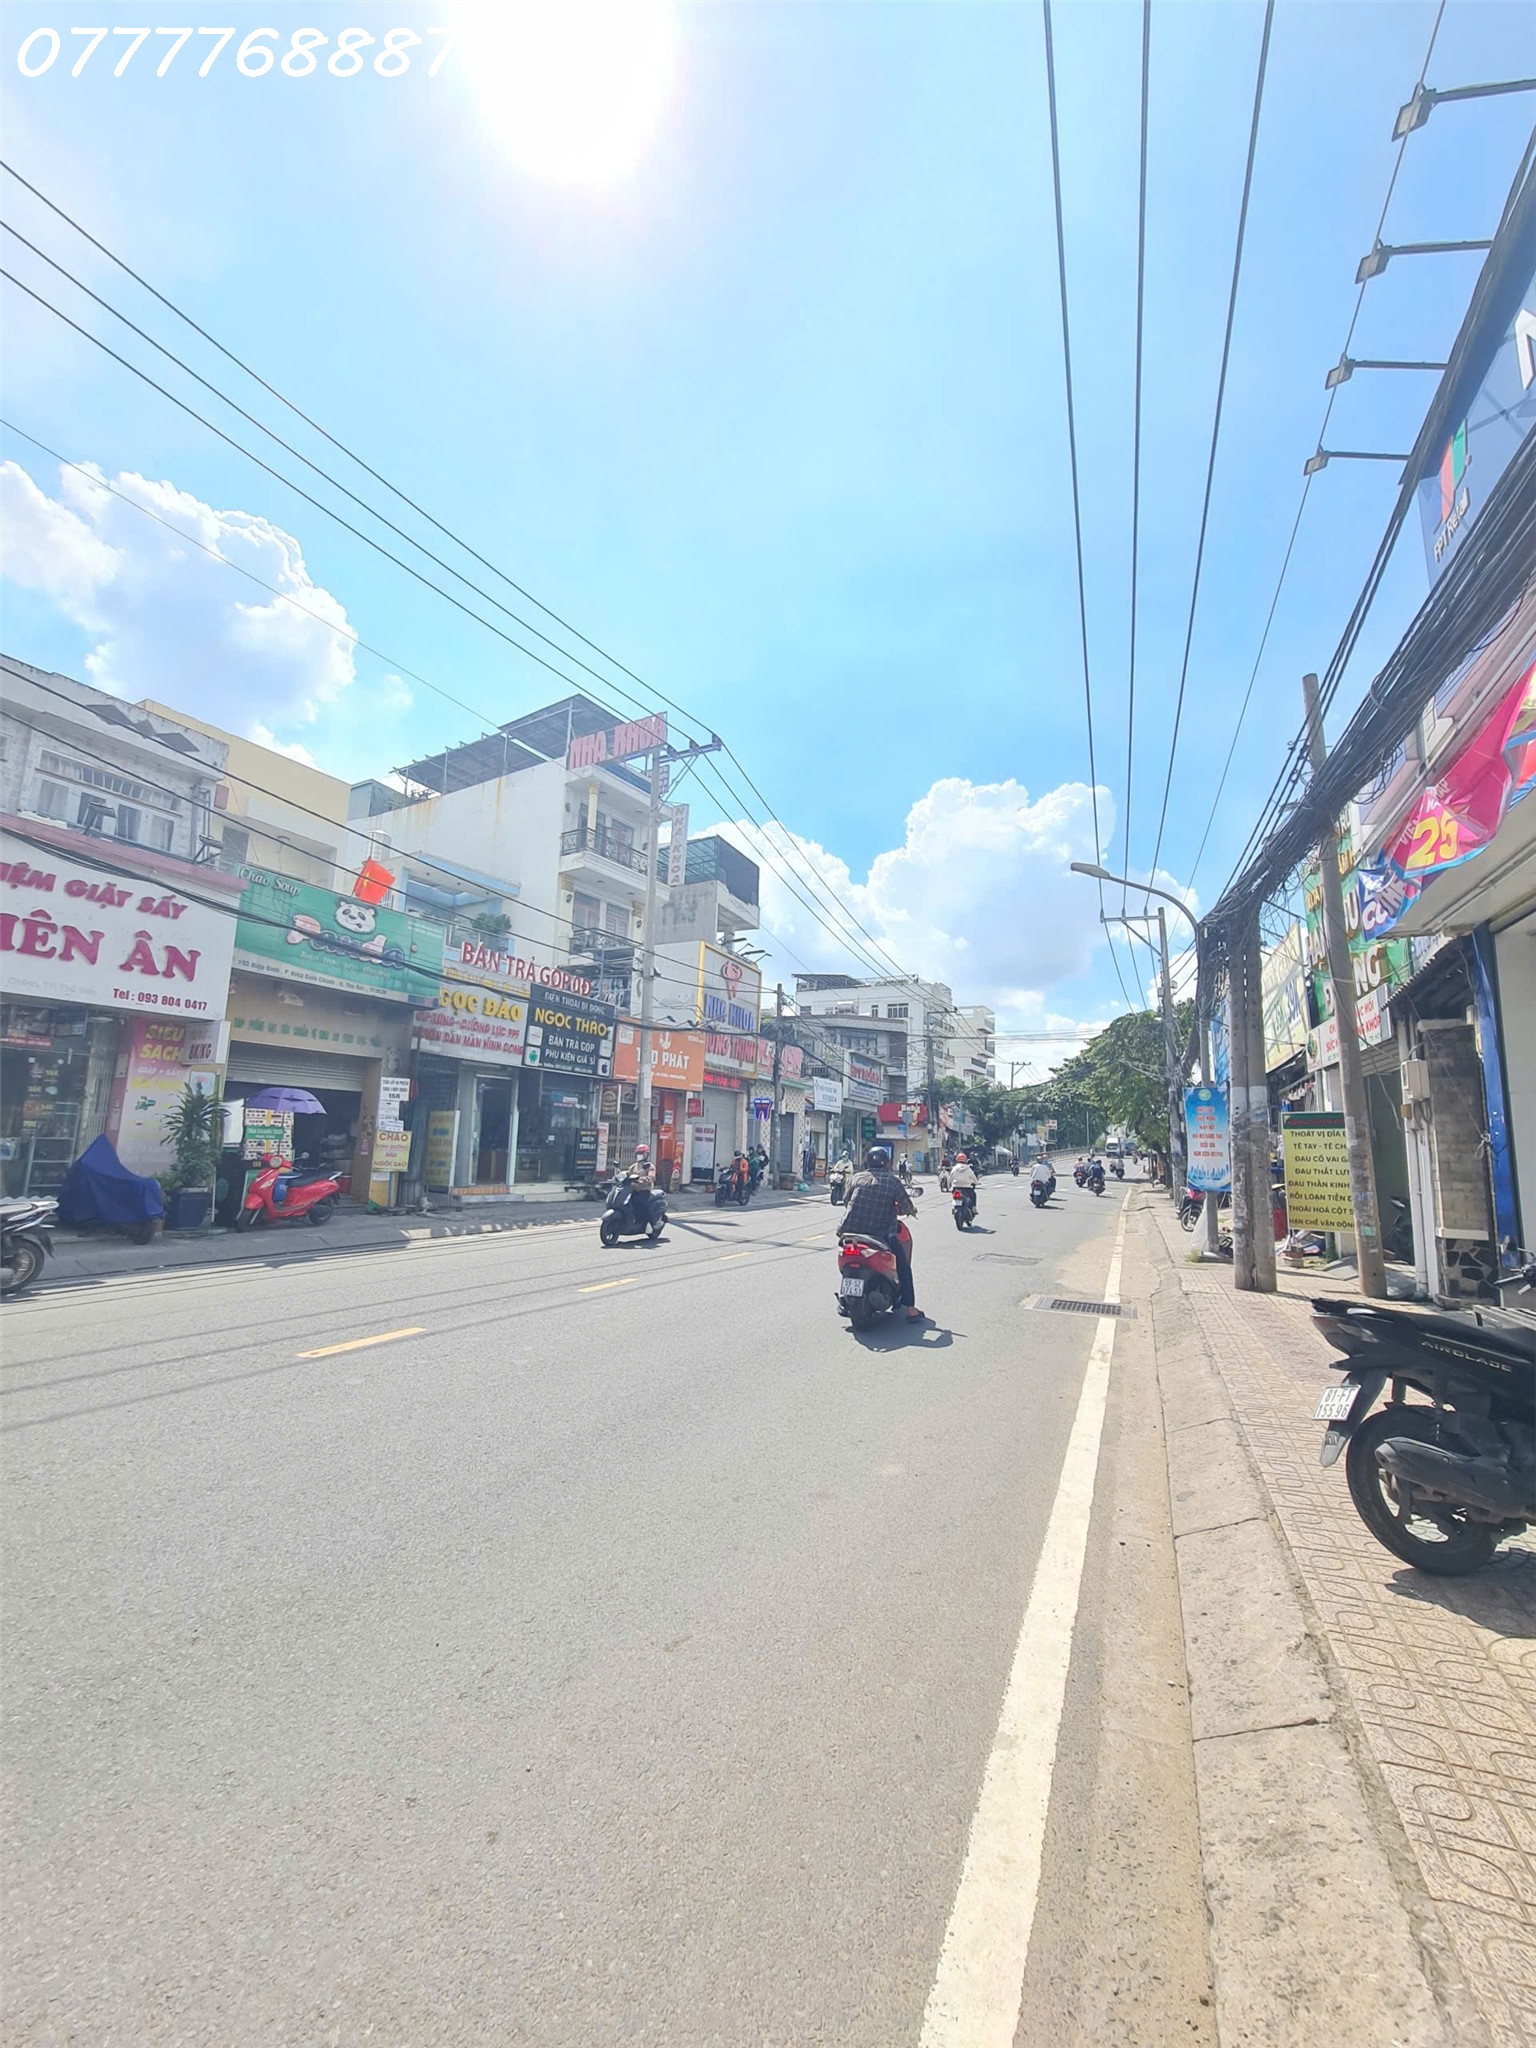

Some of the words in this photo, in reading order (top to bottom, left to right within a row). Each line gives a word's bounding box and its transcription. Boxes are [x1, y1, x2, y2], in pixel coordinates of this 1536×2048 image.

[274, 877, 301, 897] Soup
[64, 879, 133, 909] GIẶT
[136, 894, 188, 920] SẤY
[119, 930, 201, 983] ÂN
[461, 941, 501, 972] BÁN
[505, 955, 537, 982] TRẢ
[540, 965, 571, 992] GÓP
[113, 988, 130, 1001] Tel
[137, 992, 158, 1004] 093
[161, 995, 181, 1008] 804
[184, 998, 208, 1011] 0417
[534, 1007, 573, 1031] NGỌC
[662, 1050, 690, 1070] PHÁT
[1317, 1130, 1325, 1138] VỊ
[1295, 1155, 1312, 1163] ĐAU
[1326, 1155, 1339, 1163] VAI
[1295, 1167, 1312, 1175] ĐAU
[1330, 1181, 1350, 1189] KINH
[1332, 1207, 1348, 1215] CỘT
[1337, 1219, 1355, 1229] ĐỘN
